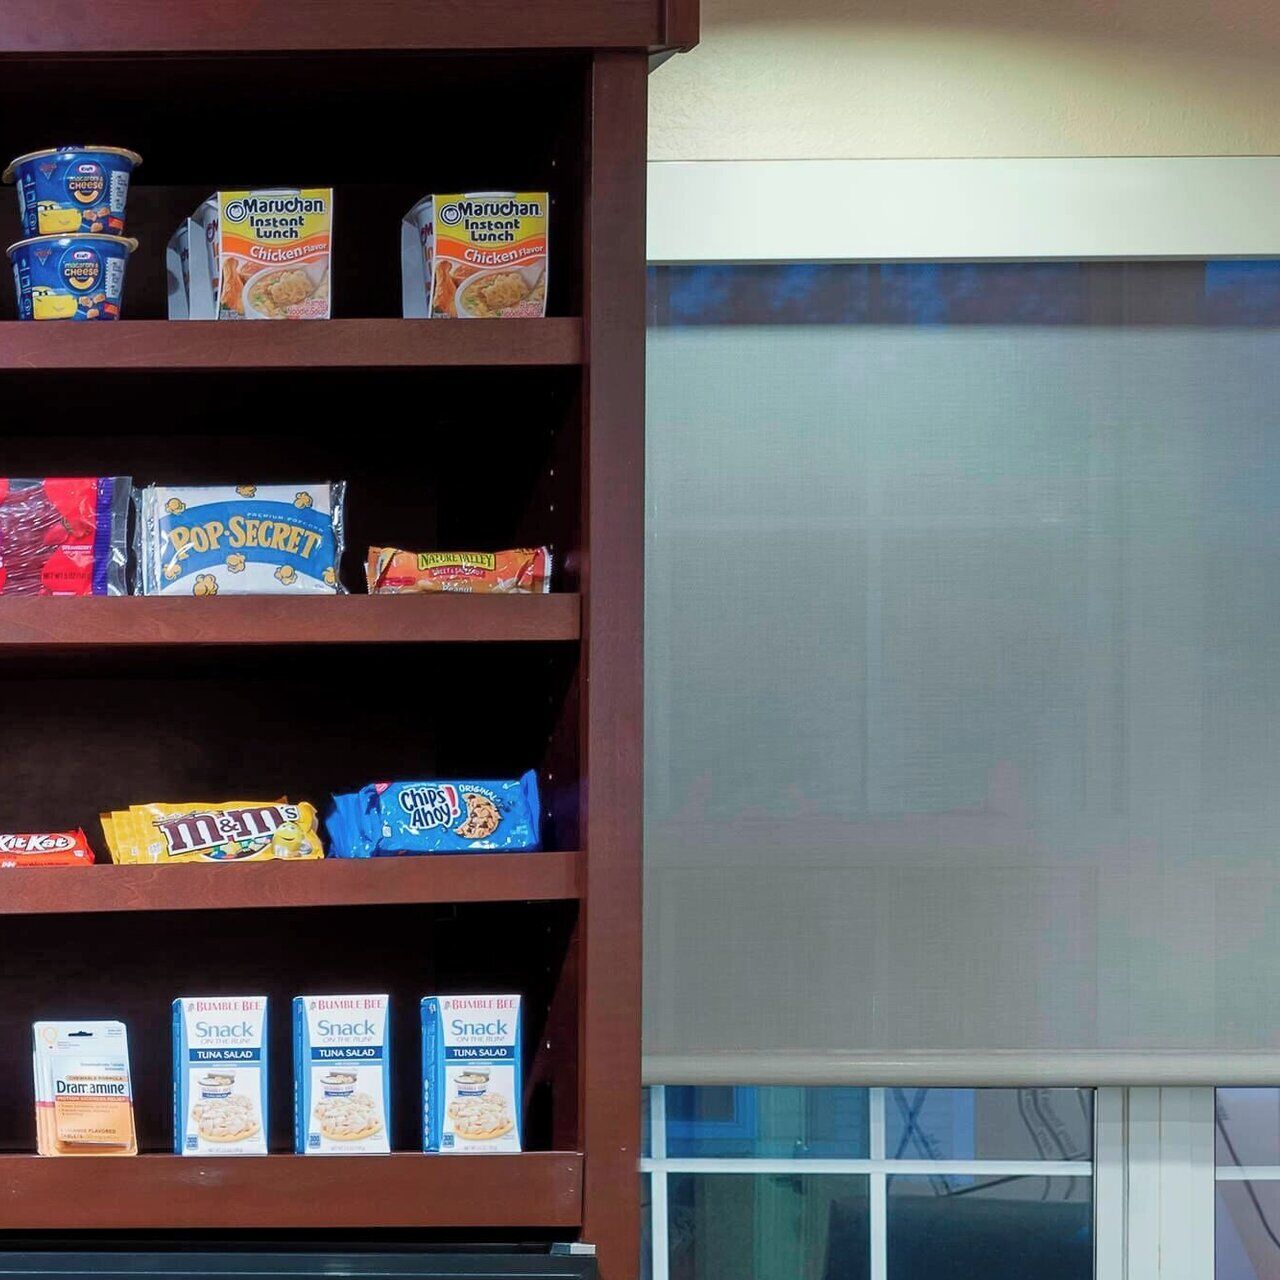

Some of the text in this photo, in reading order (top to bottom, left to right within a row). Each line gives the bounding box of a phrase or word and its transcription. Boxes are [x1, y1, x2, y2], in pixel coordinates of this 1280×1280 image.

[249, 246, 302, 262] Chicken
[420, 553, 492, 567] NATURE VALLEY
[443, 585, 473, 593] Peanut
[400, 788, 447, 812] Chips
[459, 784, 499, 803] ORIGINAL
[196, 1001, 259, 1012] BUMBLE BEE
[318, 999, 382, 1010] BUMBLE BEE
[452, 999, 516, 1010] BUMBLE BEE
[195, 1021, 253, 1037] Snack
[317, 1020, 375, 1036] Snack
[451, 1020, 507, 1036] Snack
[346, 1049, 375, 1057] SALAD
[454, 1048, 507, 1057] TUNA SALAD
